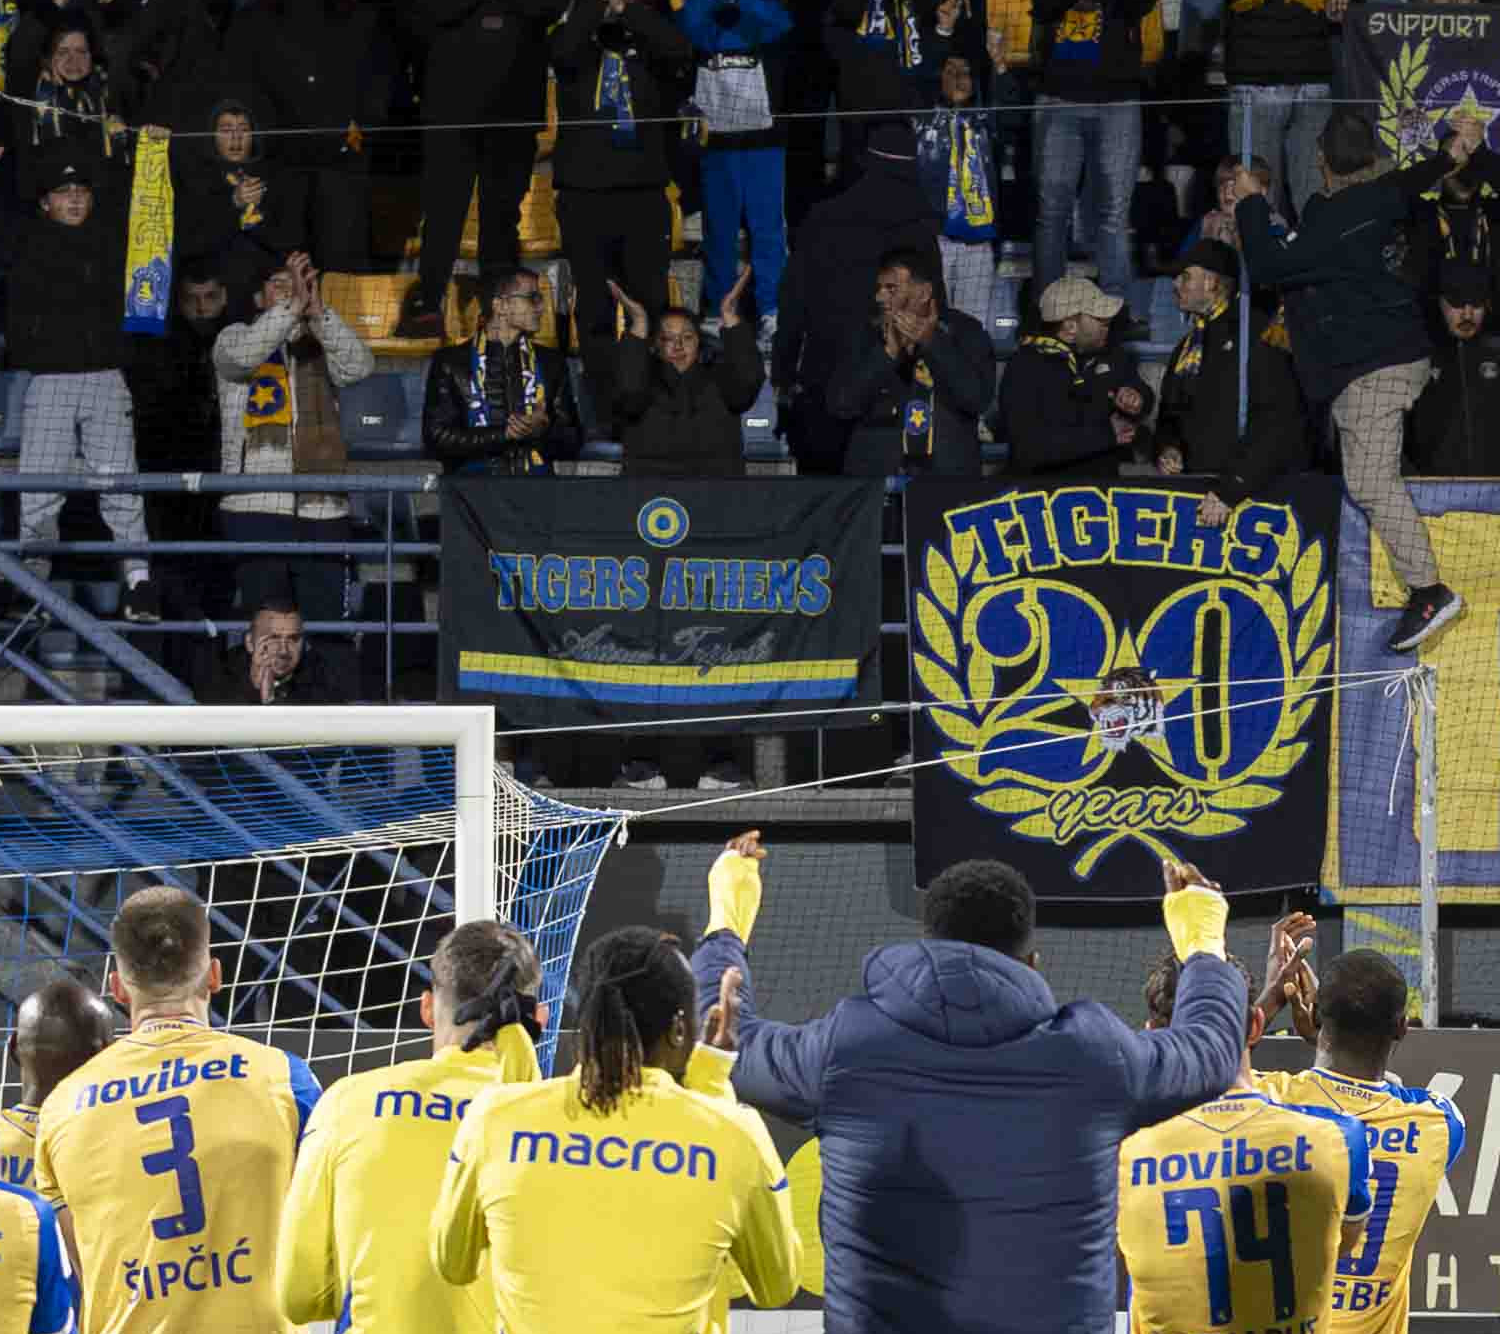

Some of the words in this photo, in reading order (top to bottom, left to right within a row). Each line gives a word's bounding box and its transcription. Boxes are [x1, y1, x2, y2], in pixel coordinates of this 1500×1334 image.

[1368, 12, 1491, 37] SUPPORT
[943, 486, 1297, 581] TIGERS
[488, 551, 650, 614] TIGERS
[660, 554, 833, 617] ATHENS
[961, 578, 1293, 788] 20
[1047, 785, 1207, 845] years
[74, 1051, 251, 1113] novibet
[135, 1093, 206, 1241] 3
[509, 1129, 718, 1181] macron
[1131, 1134, 1313, 1186] novibet
[122, 1236, 254, 1304] ŠIPČIĆ
[1161, 1180, 1296, 1327] 74
